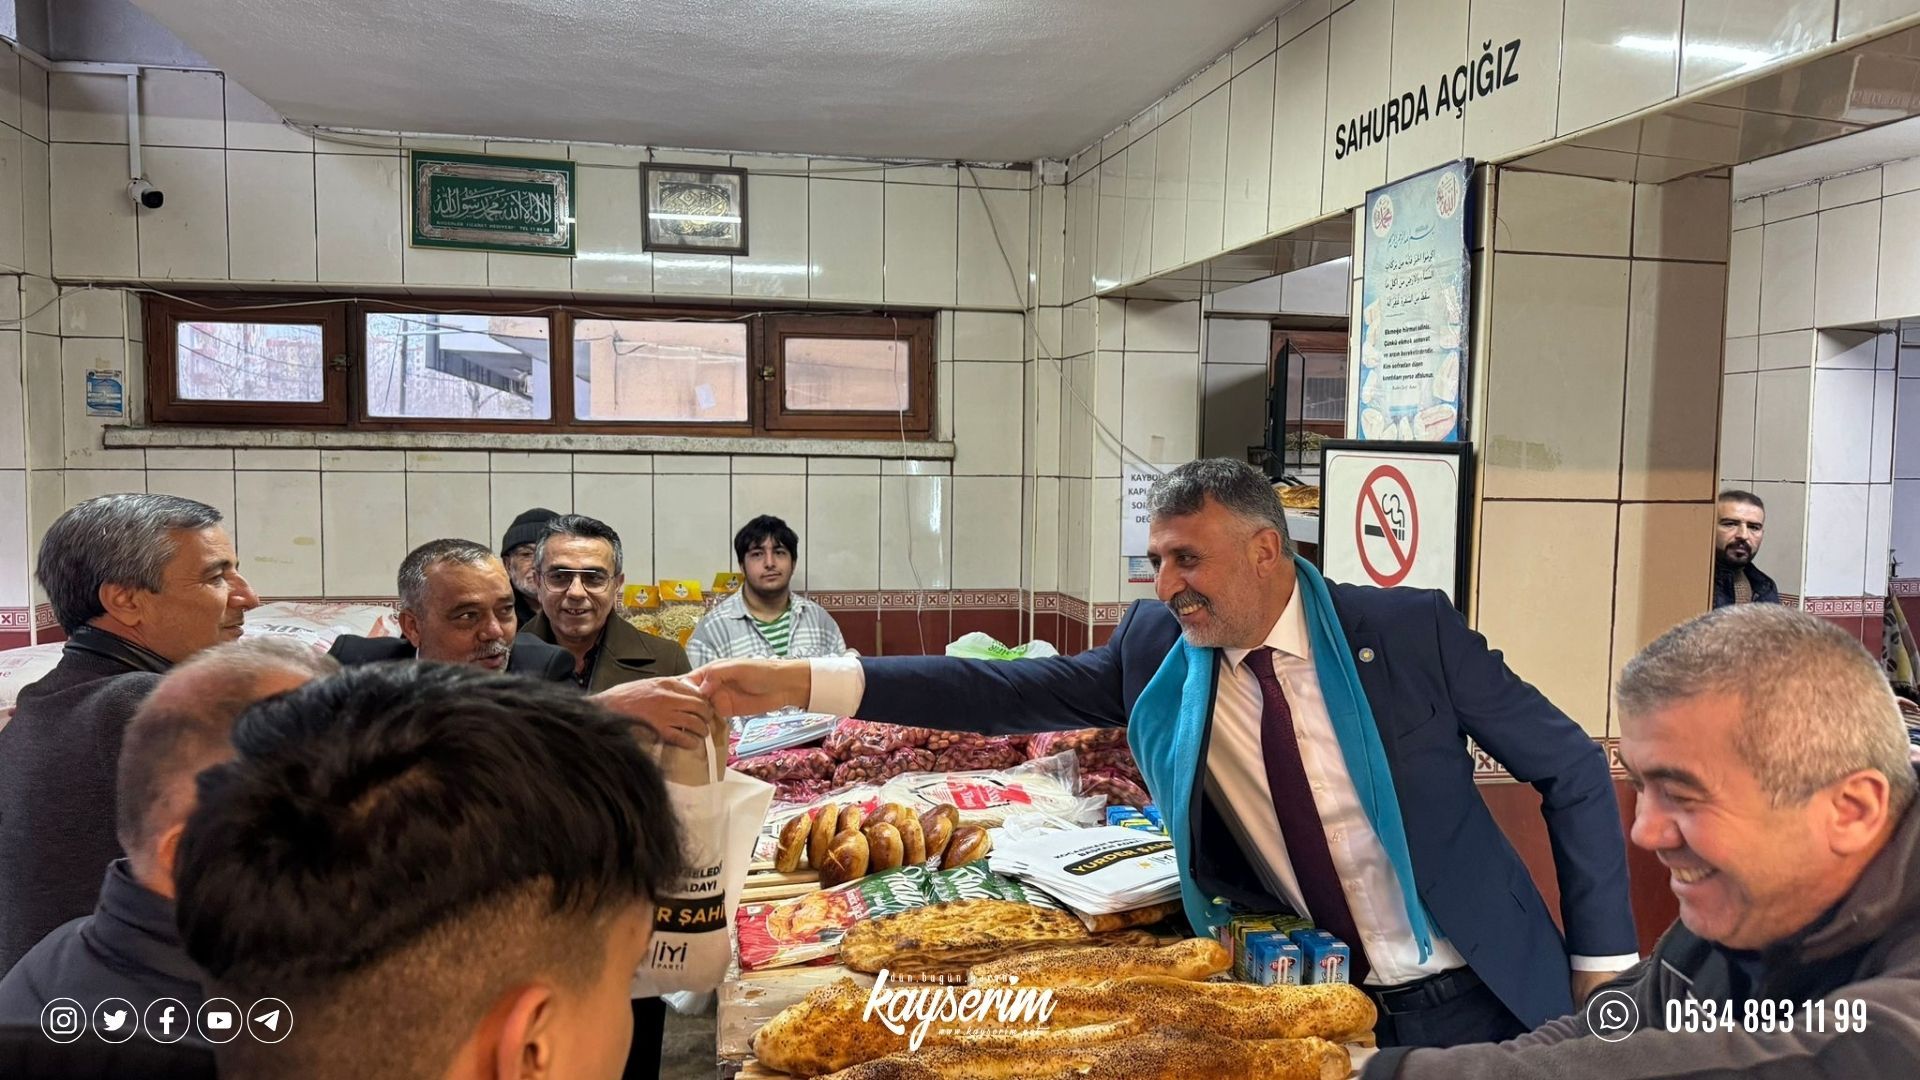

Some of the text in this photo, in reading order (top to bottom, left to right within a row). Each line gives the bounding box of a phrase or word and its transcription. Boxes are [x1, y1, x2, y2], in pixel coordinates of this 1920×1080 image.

[1335, 39, 1521, 160] SAHURDA AÇIĞIZ
[1072, 850, 1137, 873] YURDER
[659, 941, 688, 963] İYİ
